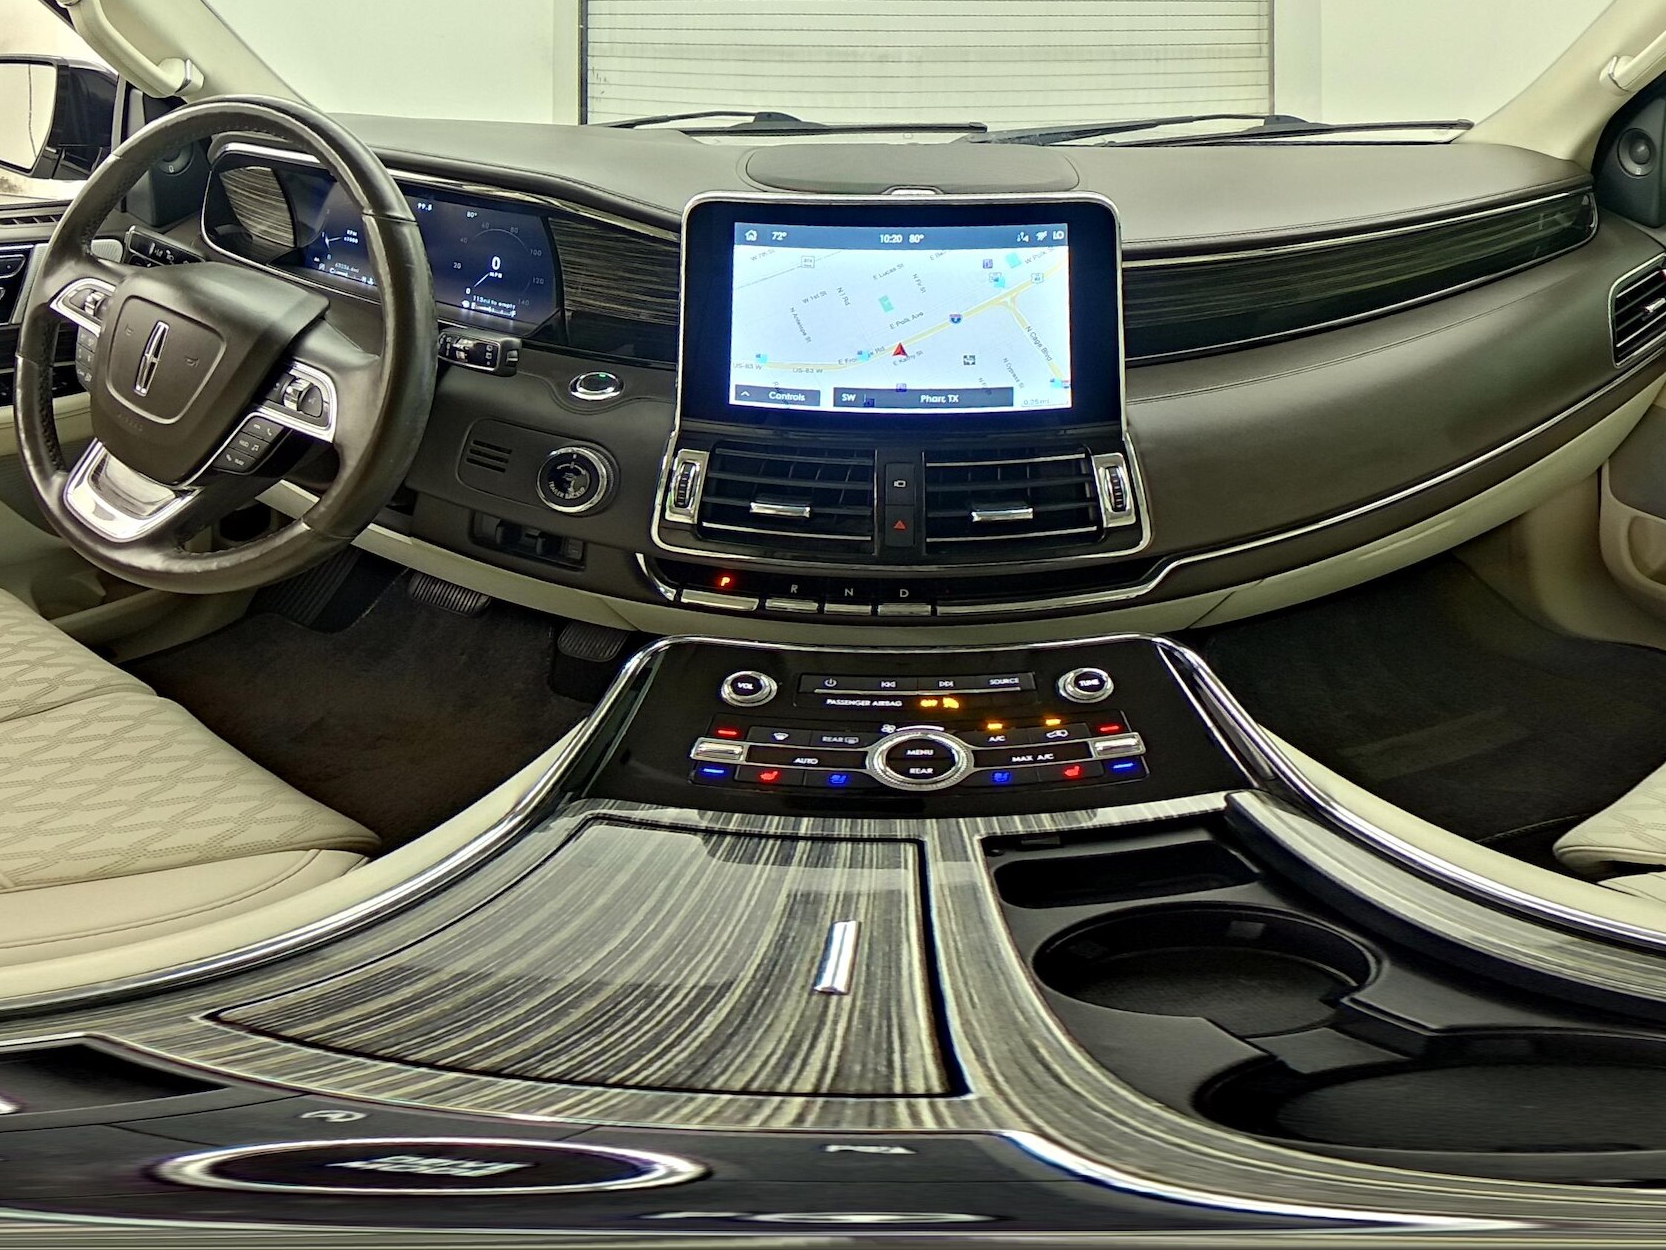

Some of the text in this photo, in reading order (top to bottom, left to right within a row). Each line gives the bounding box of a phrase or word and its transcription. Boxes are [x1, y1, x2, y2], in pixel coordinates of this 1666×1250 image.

[771, 231, 788, 241] 72°
[879, 234, 903, 244] 10:20
[908, 234, 925, 244] 80°
[1052, 230, 1065, 240] LO
[453, 261, 462, 270] 20
[491, 255, 501, 271] 0
[465, 287, 471, 295] 0
[768, 391, 806, 402] Controls
[841, 394, 857, 402] SW
[947, 394, 959, 403] TX
[720, 576, 731, 587] P
[790, 584, 799, 594] R
[844, 588, 854, 597] N
[899, 589, 909, 598] D
[737, 681, 754, 690] VOL
[989, 677, 1020, 686] SOURCE
[1077, 678, 1100, 687] TUNE
[826, 698, 871, 707] PASSENGER
[871, 699, 903, 708] AIRBAG
[822, 736, 843, 744] REAR
[988, 735, 1006, 743] A/C
[906, 748, 935, 756] MENU
[793, 757, 819, 765] AUTO
[1036, 753, 1055, 761] A/C
[909, 767, 934, 775] REAR
